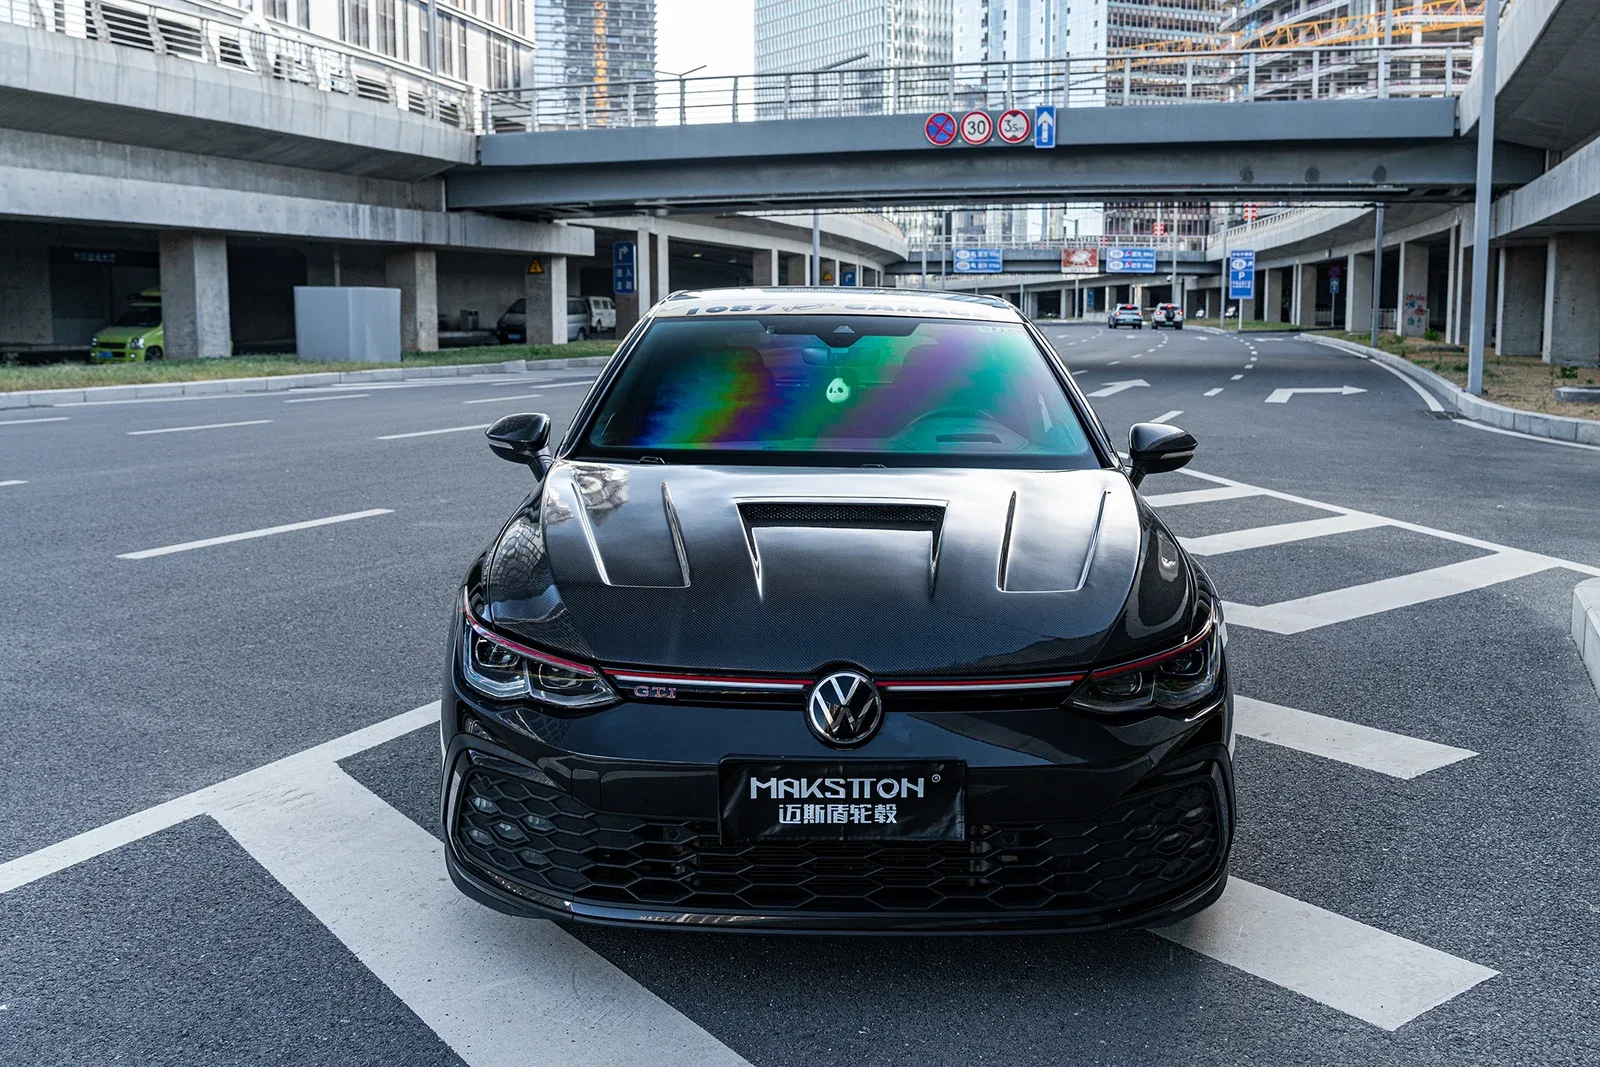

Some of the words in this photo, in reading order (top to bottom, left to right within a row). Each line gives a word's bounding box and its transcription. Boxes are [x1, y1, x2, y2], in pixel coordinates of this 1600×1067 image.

[967, 120, 986, 135] 30
[634, 685, 676, 699] GTI
[779, 804, 897, 824] 迈斯盾轮毂
